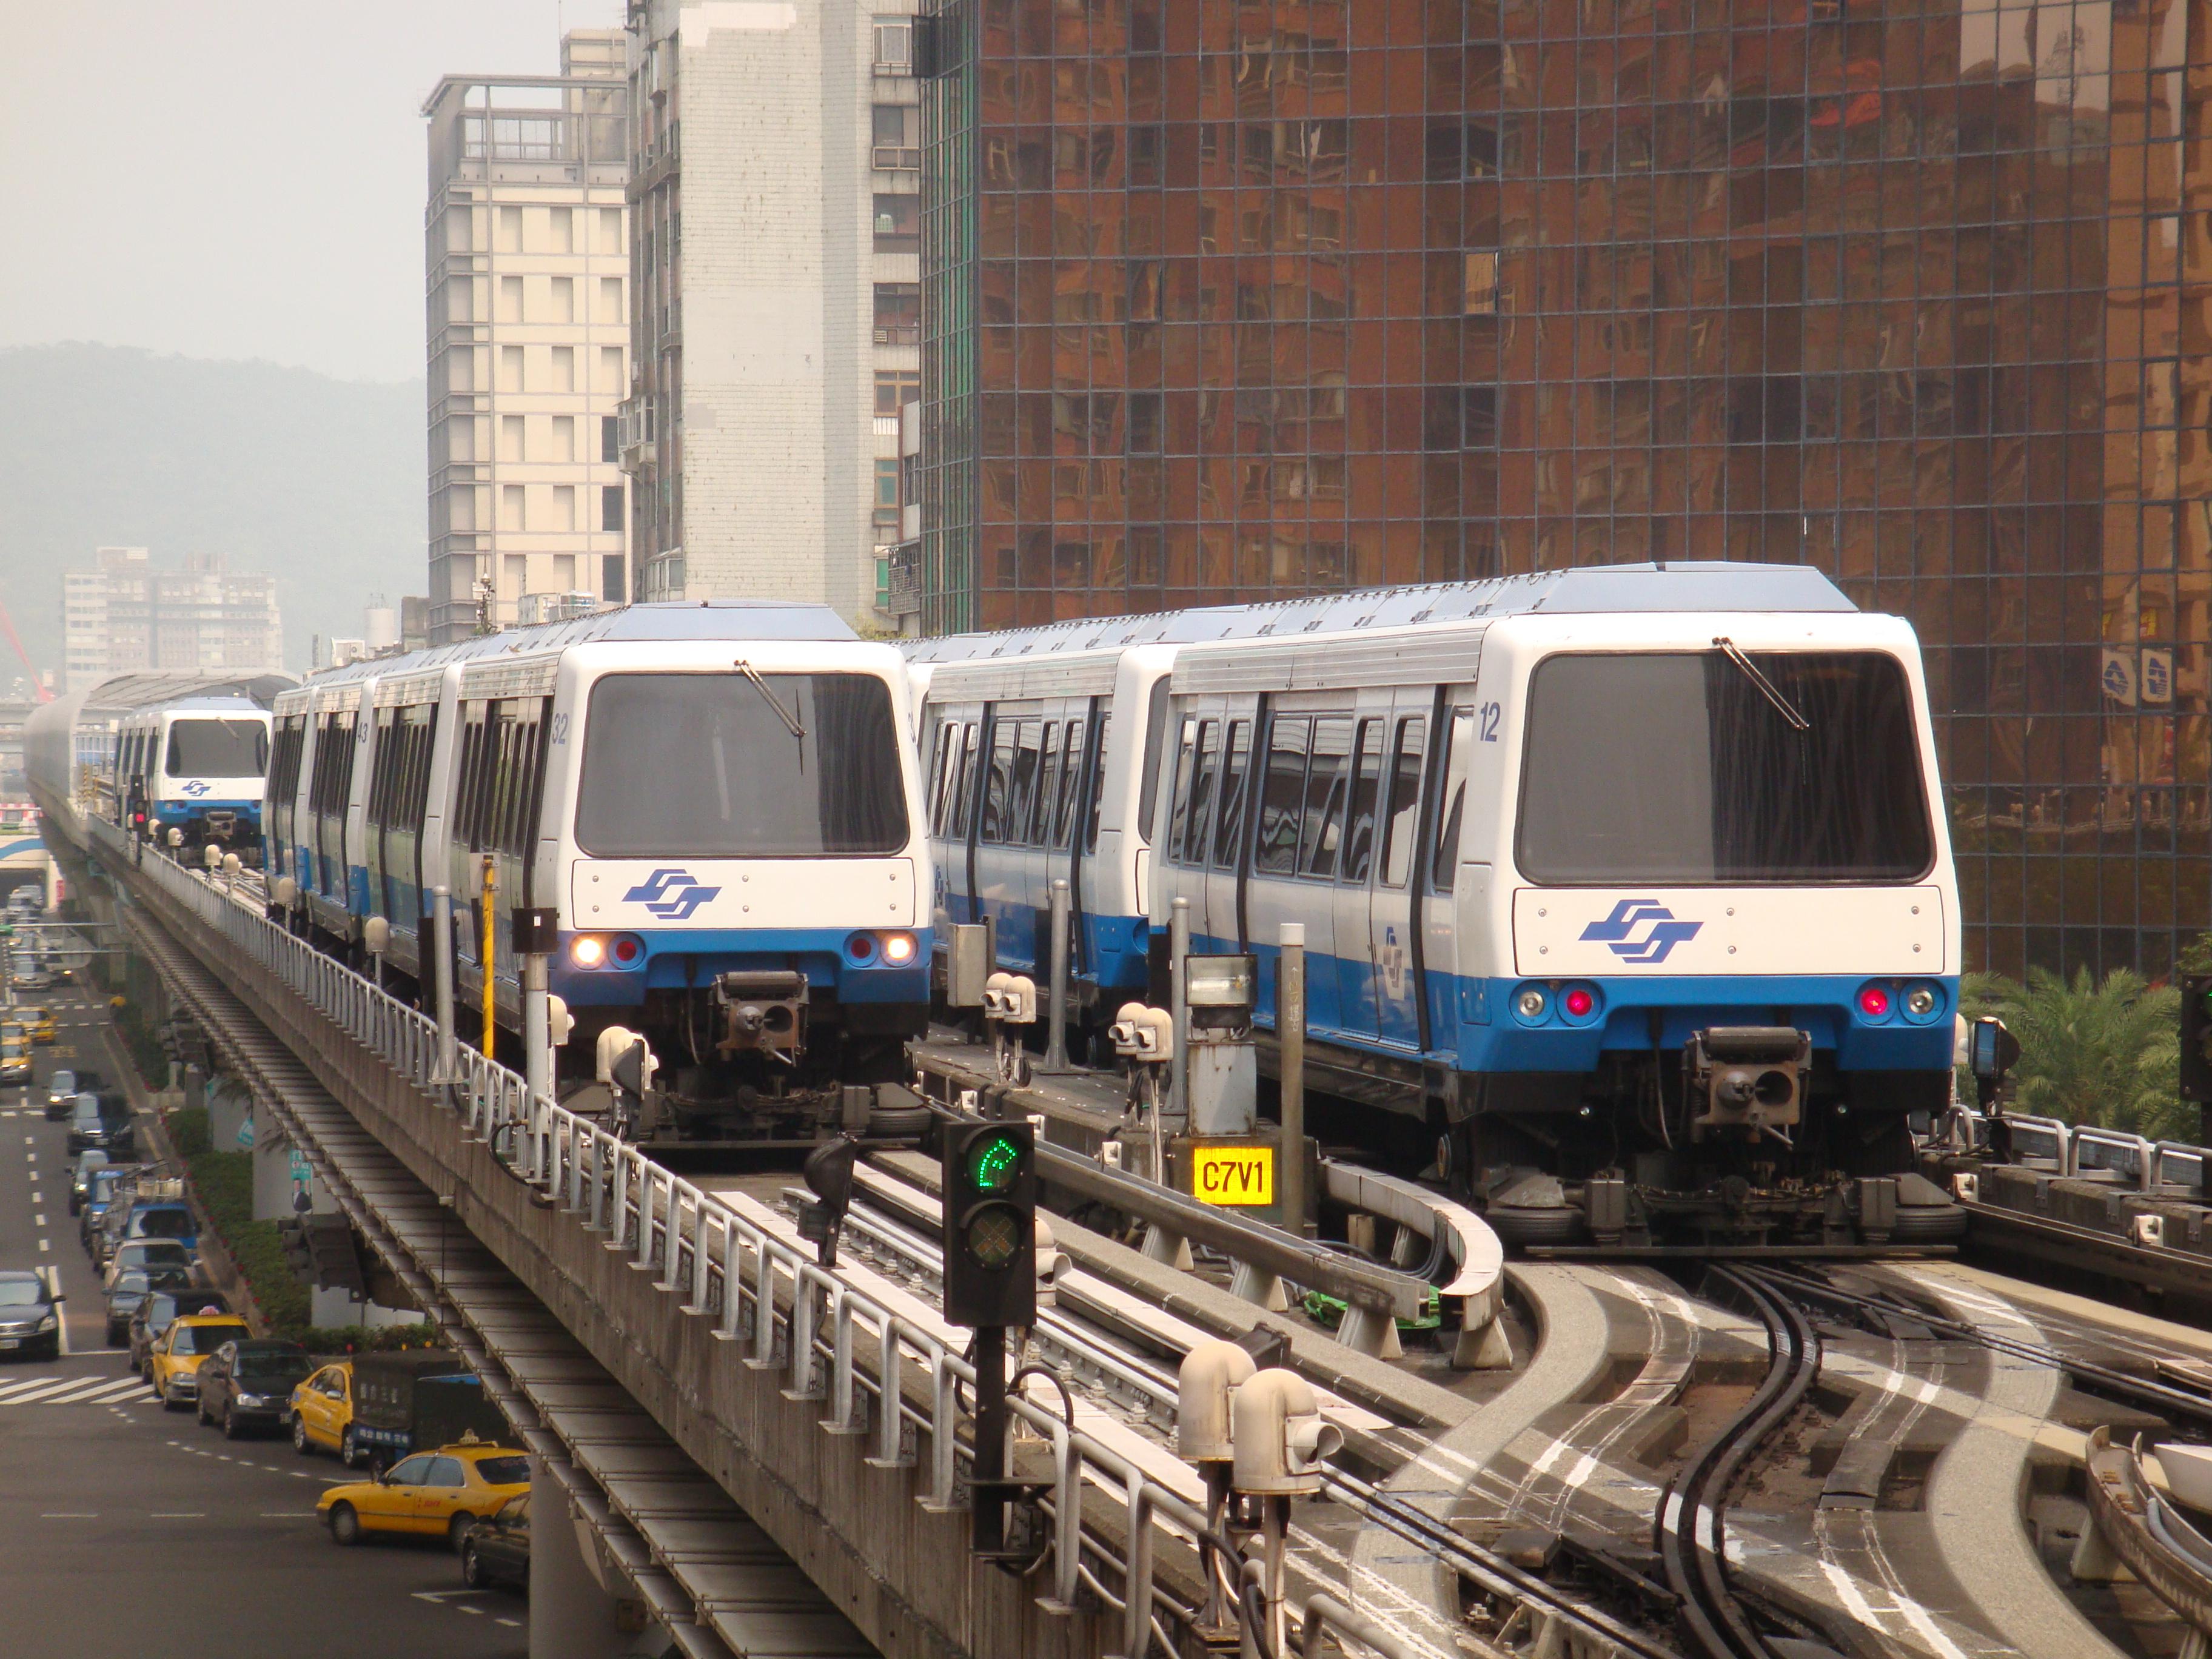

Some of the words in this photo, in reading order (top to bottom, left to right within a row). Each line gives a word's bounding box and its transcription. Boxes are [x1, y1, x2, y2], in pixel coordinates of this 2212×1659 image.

[357, 722, 368, 743] 43
[552, 713, 568, 744] 32
[1480, 702, 1501, 742] 12
[1203, 1161, 1262, 1193] C7V1
